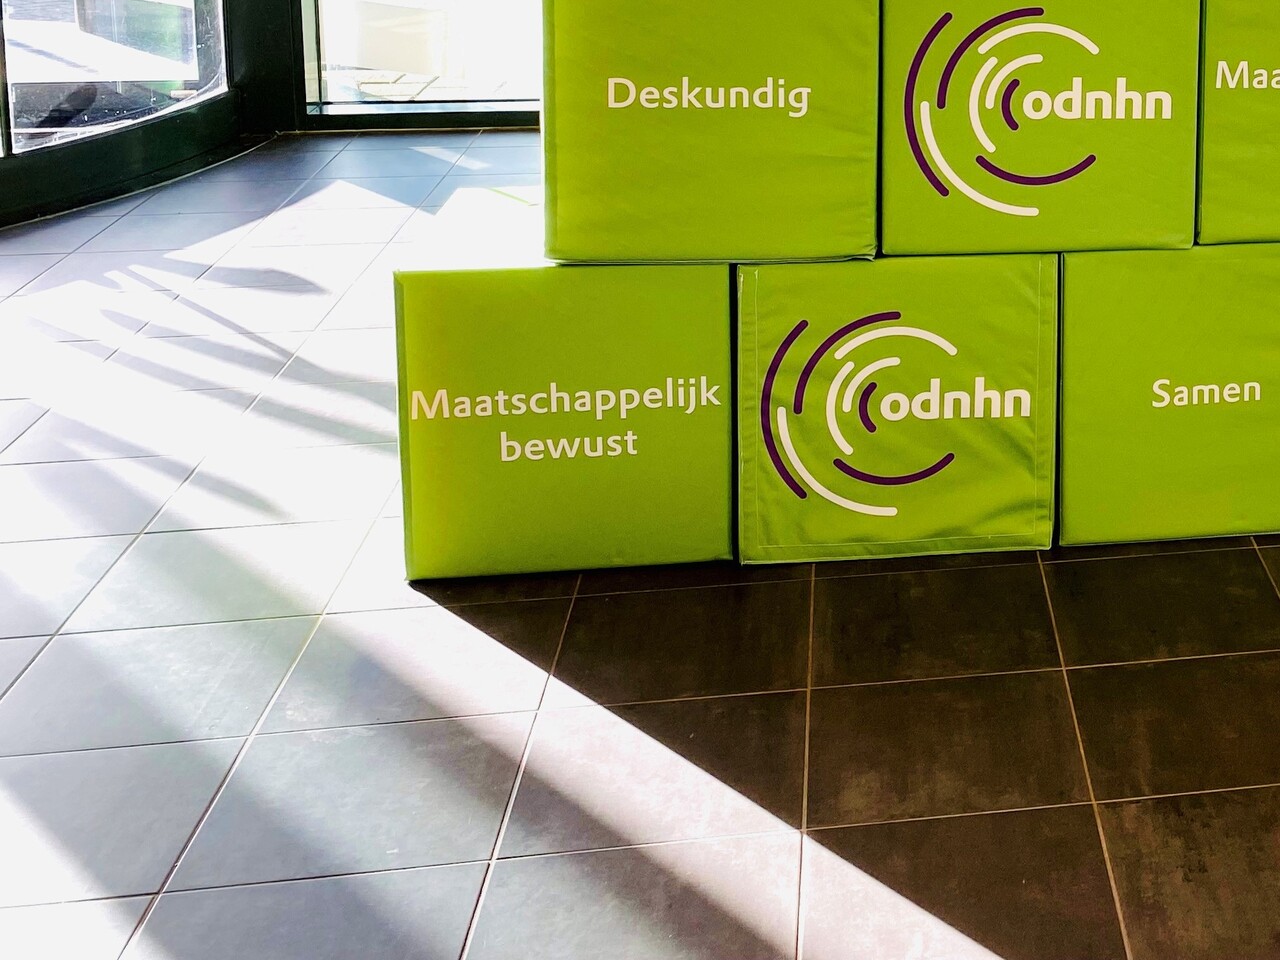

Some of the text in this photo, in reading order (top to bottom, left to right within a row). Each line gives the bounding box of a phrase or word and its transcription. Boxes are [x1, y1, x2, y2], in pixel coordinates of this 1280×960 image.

[608, 77, 811, 118] Deskundig
[1021, 76, 1172, 120] odnhn
[412, 376, 721, 420] Maatschappelijk
[880, 376, 1031, 421] odnhn
[1152, 379, 1261, 408] Samen
[500, 430, 638, 462] bewust
